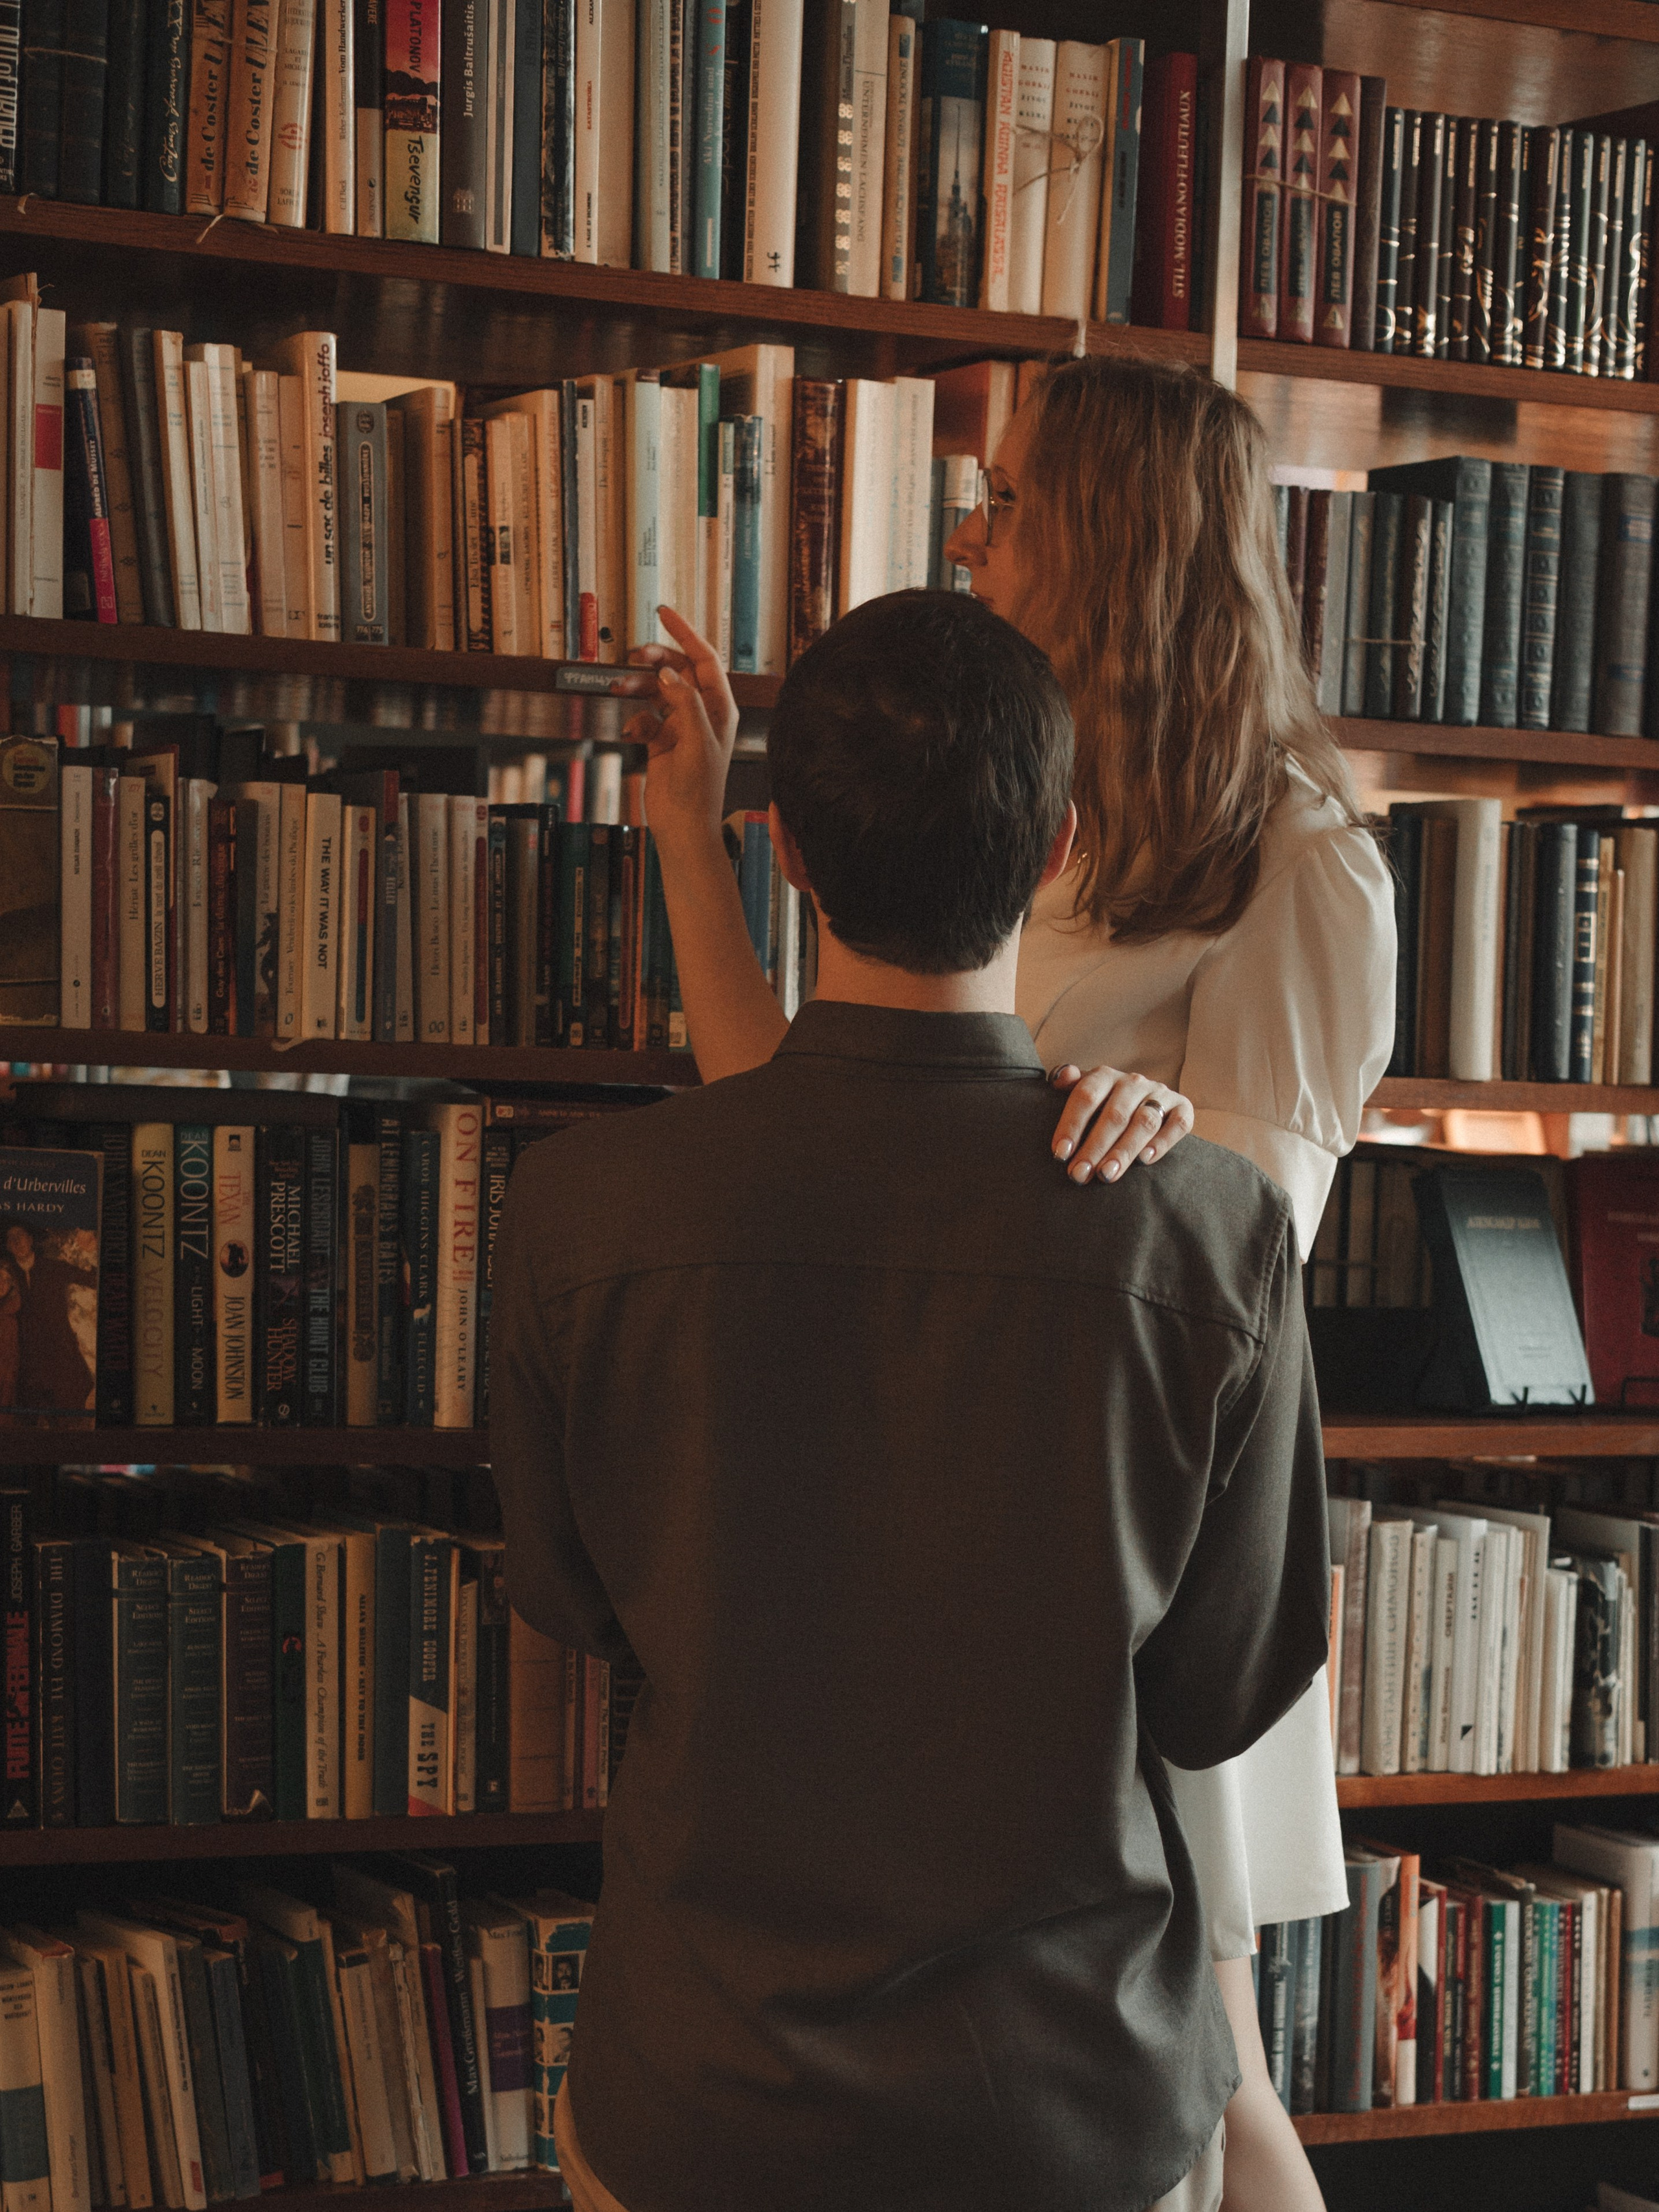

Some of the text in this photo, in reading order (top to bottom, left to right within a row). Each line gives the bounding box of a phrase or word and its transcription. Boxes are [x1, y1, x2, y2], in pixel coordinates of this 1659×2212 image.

[408, 0, 423, 73] PLATONOV
[463, 0, 475, 118] Jurgis Baltrušaitis.
[338, 54, 347, 74] Vom
[200, 69, 219, 172] de Coster
[245, 73, 264, 146] Coster
[246, 148, 262, 176] de
[89, 439, 98, 472] MUSSET
[316, 343, 334, 566] un sac de billes joseph joffo
[94, 486, 103, 518] ALFRED
[130, 811, 138, 831] d'or
[129, 831, 139, 862] grilles
[129, 864, 138, 882] Les
[317, 836, 332, 970] THE WAY IT WAS NOT
[154, 921, 163, 956] BAZIN
[141, 1149, 167, 1158] DEAN
[3, 1176, 86, 1194] d'Urbervilles
[180, 1140, 209, 1261] KOONTZ
[218, 1170, 242, 1227] TEXAN
[377, 1118, 400, 1285] AT LENINGRAD'S GATES
[489, 1174, 505, 1203] IRIS
[16, 1203, 65, 1213] HARDY
[141, 1160, 166, 1259] KOONTZ
[270, 1181, 286, 1273] PRESCOTT
[286, 1185, 301, 1269] MICHAEL
[419, 1190, 430, 1250] HIGGINS
[308, 1135, 331, 1393] JOHN LESCROART THE HUNT CLUB
[453, 1111, 478, 1392] ON FIRE JOHN O'LEARY
[418, 1254, 428, 1298] CLARK
[142, 1267, 164, 1379] VELOCITY
[191, 1286, 204, 1326] LIGHT
[191, 1347, 204, 1390] MOON
[223, 1295, 245, 1400] JOAN JOHNSTON
[266, 1328, 283, 1392] HUNTER
[282, 1317, 297, 1385] SHADOW
[10, 1503, 23, 1603] JOSEPH GARBER
[49, 1557, 64, 1582] THE
[316, 1564, 327, 1602] Bernard
[50, 1591, 64, 1669] DIAMOND
[316, 1604, 327, 1629] Shaw
[316, 1650, 327, 1683] Fearless
[422, 1640, 437, 1682] COOPER
[314, 1687, 328, 1734] Champion
[318, 1749, 328, 1762] the
[318, 1764, 328, 1789] Truth
[416, 1723, 439, 1788] THE SPY
[447, 1899, 461, 1934] Gold
[458, 1991, 476, 2067] Großmann
[466, 2067, 480, 2095] Max
